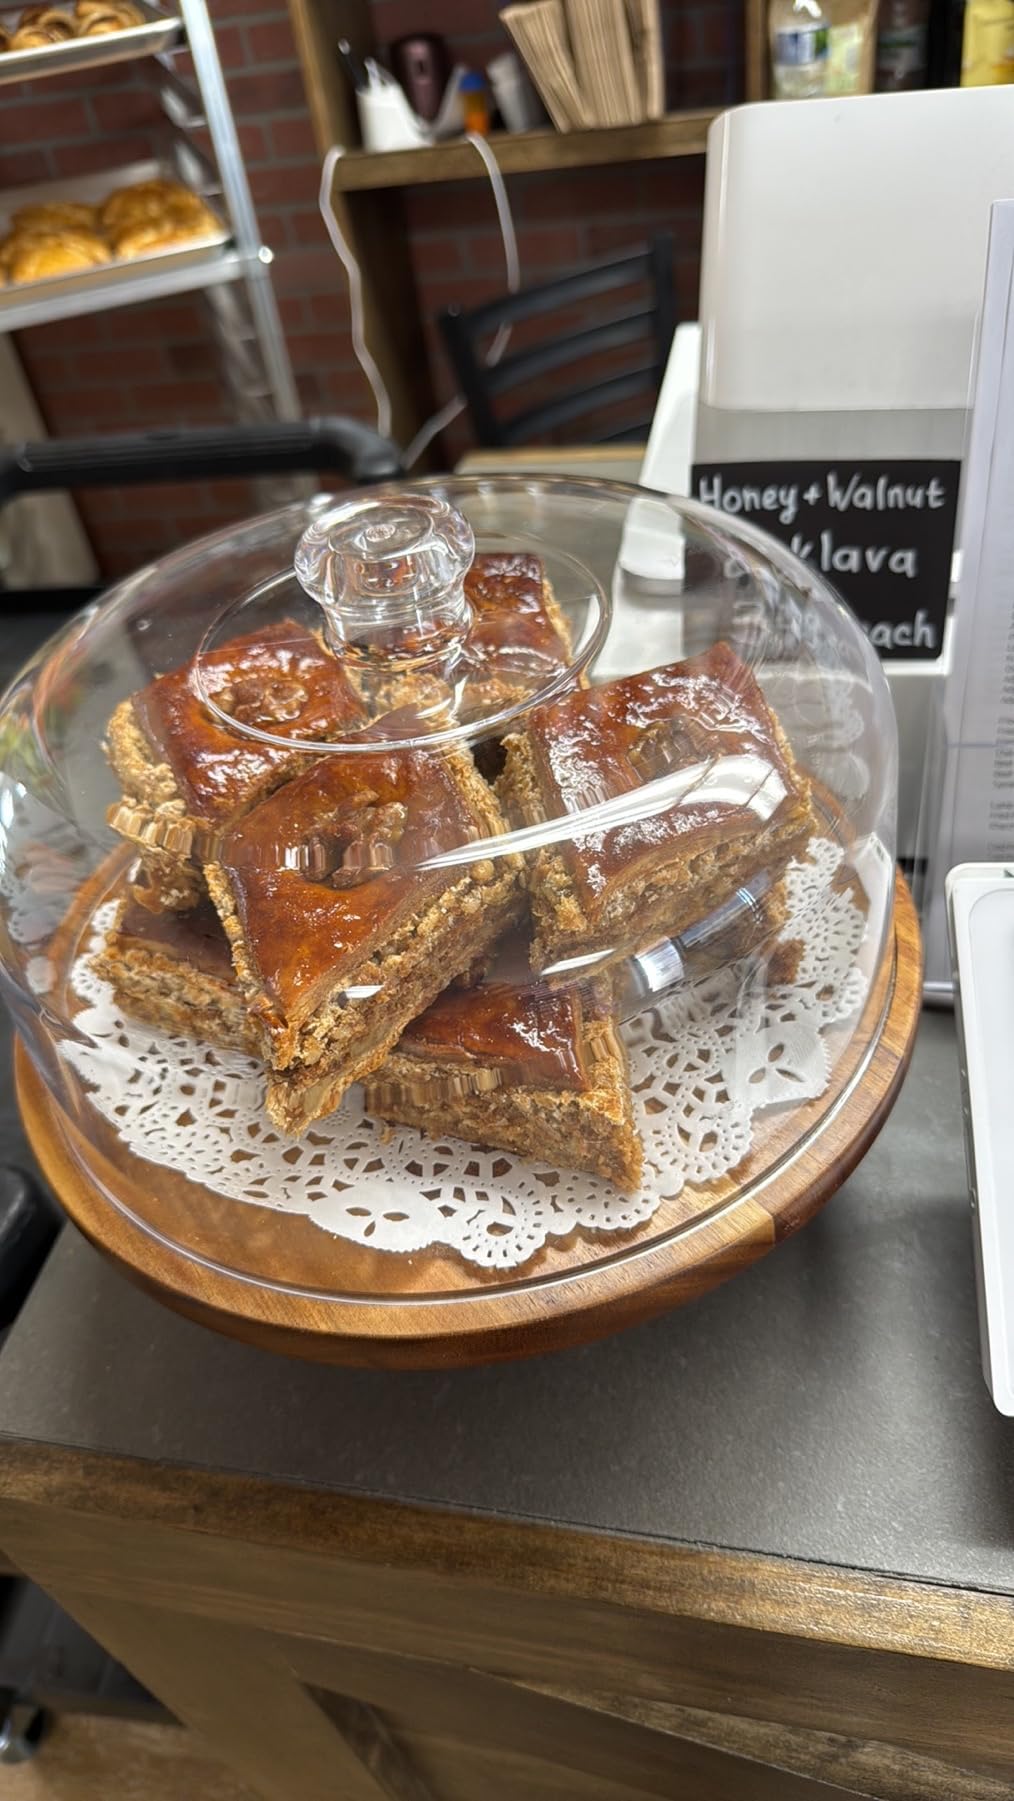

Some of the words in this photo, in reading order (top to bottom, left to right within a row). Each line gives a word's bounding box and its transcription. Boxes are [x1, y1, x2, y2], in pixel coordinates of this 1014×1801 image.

[699, 473, 799, 525] Honey
[802, 482, 822, 506] +
[826, 470, 945, 512] Walnut
[862, 607, 936, 649] ach
